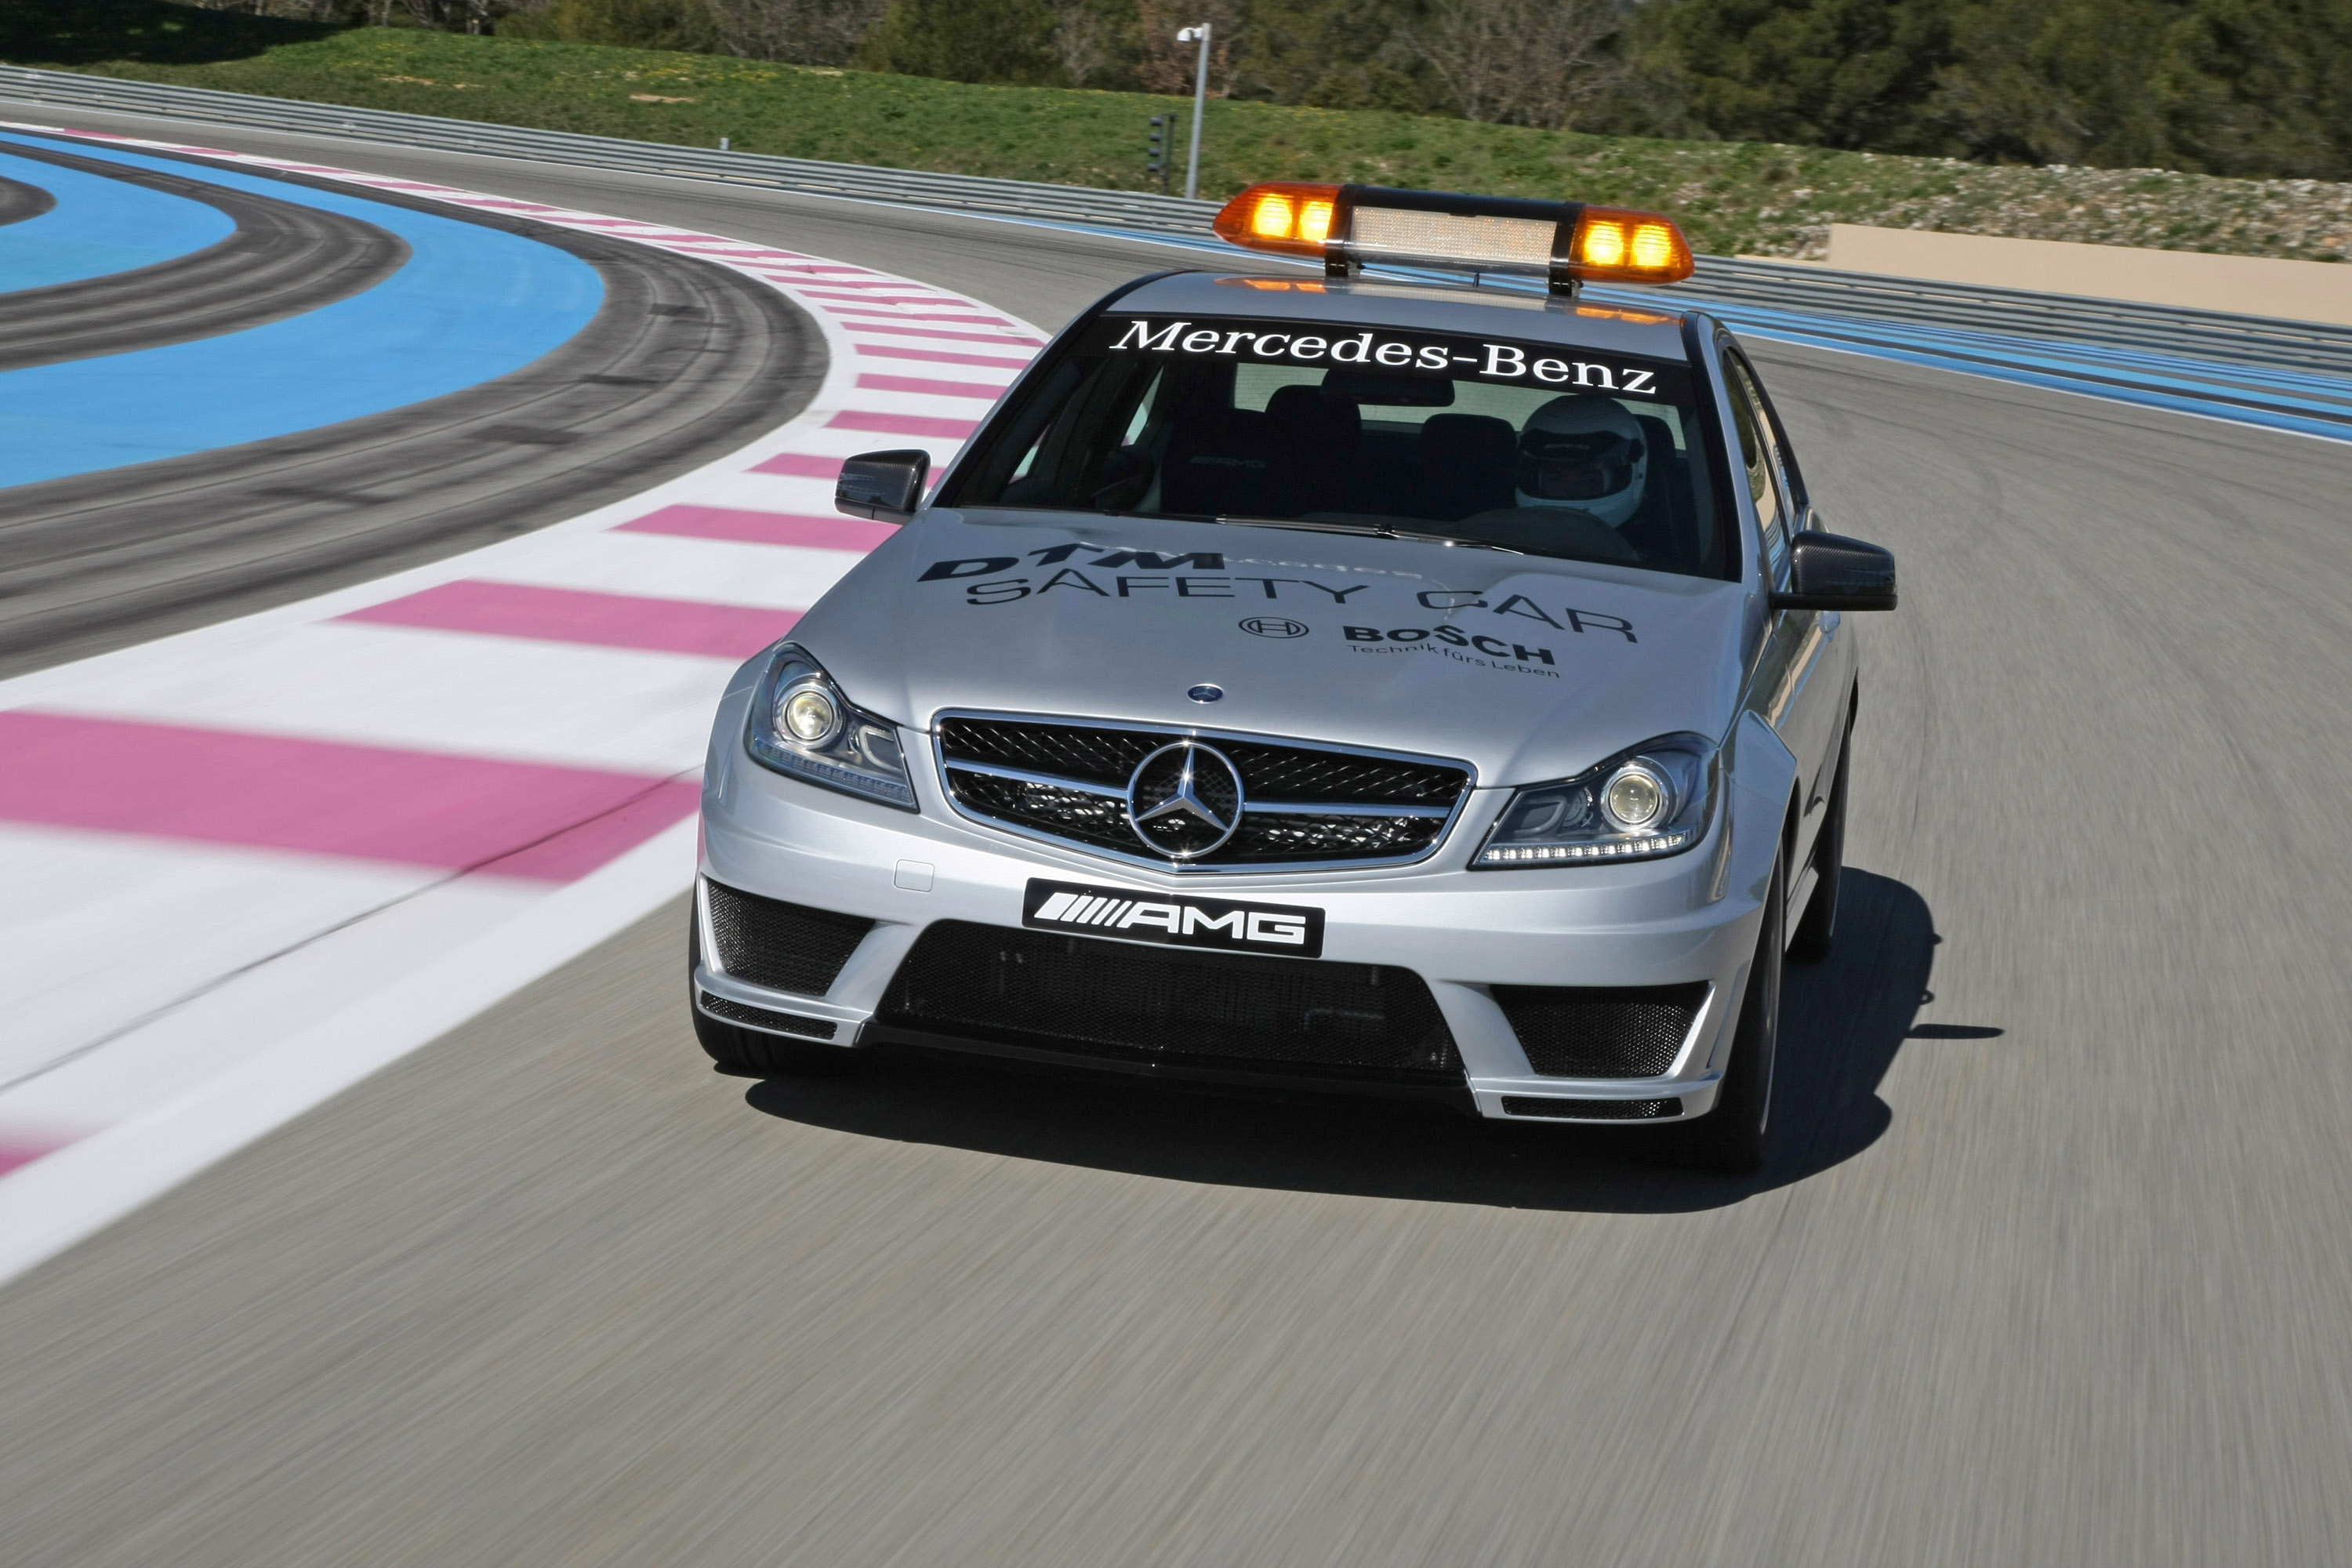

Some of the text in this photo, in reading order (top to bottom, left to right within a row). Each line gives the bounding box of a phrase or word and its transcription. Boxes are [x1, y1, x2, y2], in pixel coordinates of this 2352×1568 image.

[1109, 320, 1657, 395] Mercedes-Benz
[916, 543, 1225, 582] DTM
[967, 568, 1639, 643] SAFETY CAR
[1342, 624, 1555, 665] BOSCH
[1348, 643, 1560, 678] Technik fürs Leben
